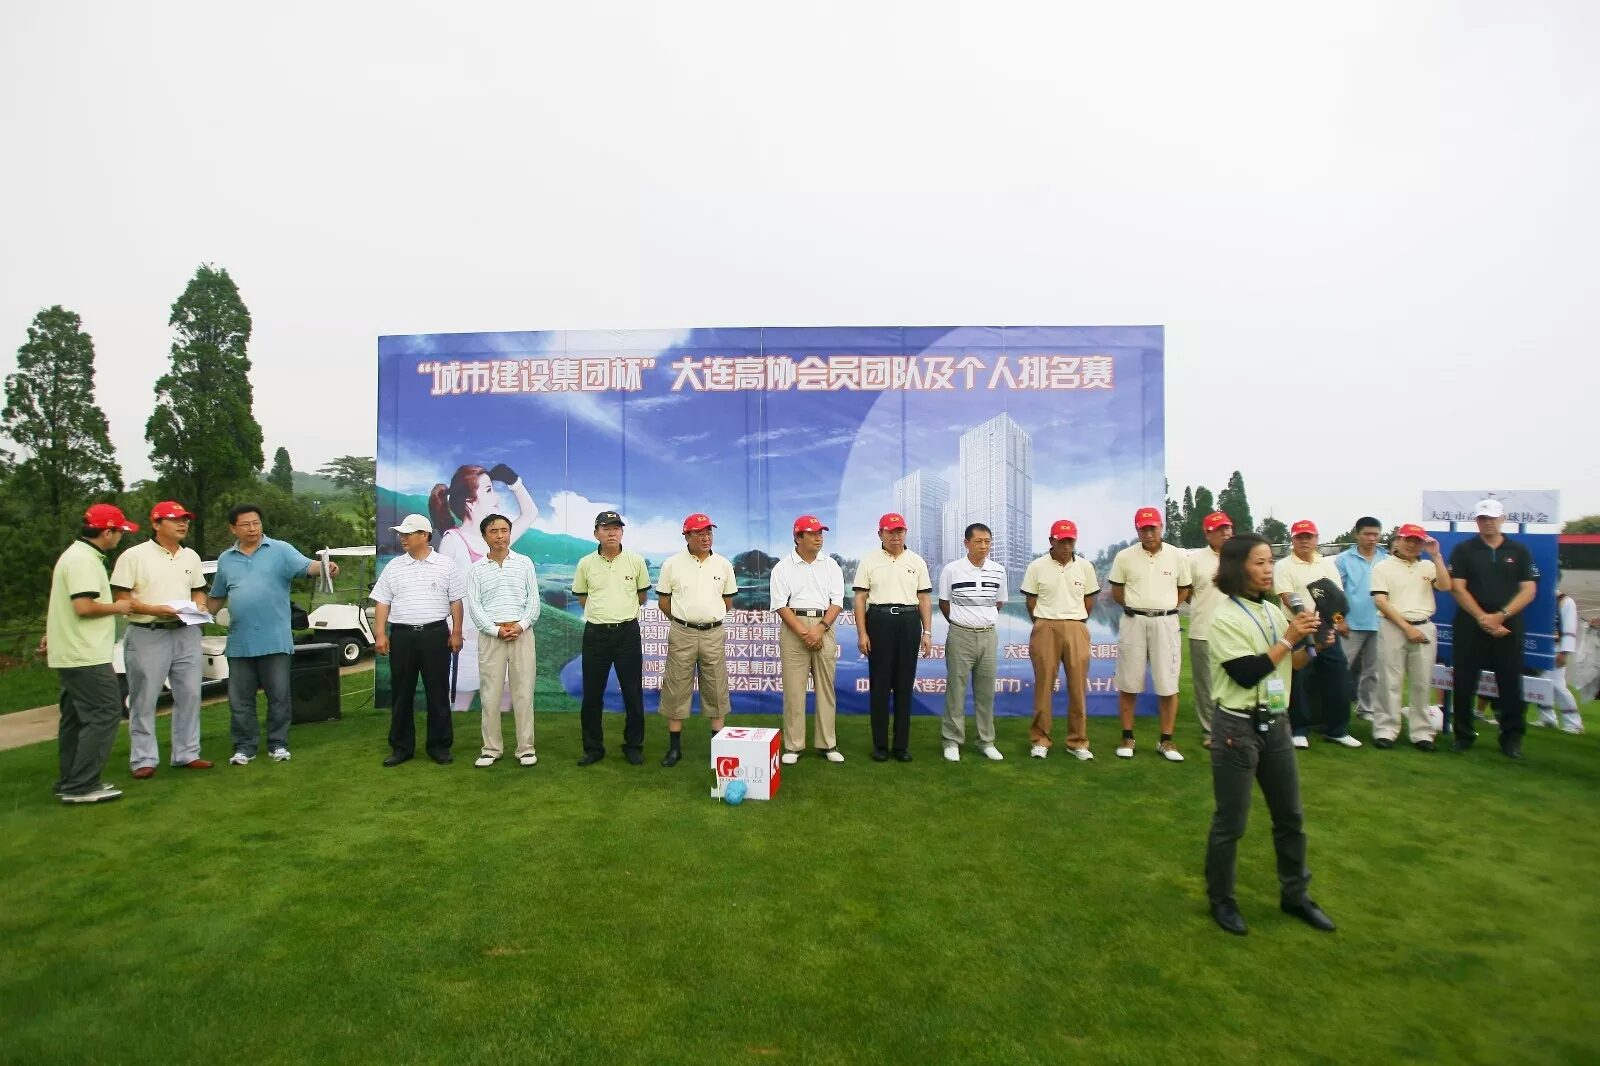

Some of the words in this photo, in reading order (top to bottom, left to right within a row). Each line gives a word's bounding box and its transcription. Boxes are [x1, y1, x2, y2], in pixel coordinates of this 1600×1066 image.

[417, 359, 656, 396] “城市建设集团杯”
[671, 355, 1114, 392] 大连高协会员团队及个人排名赛
